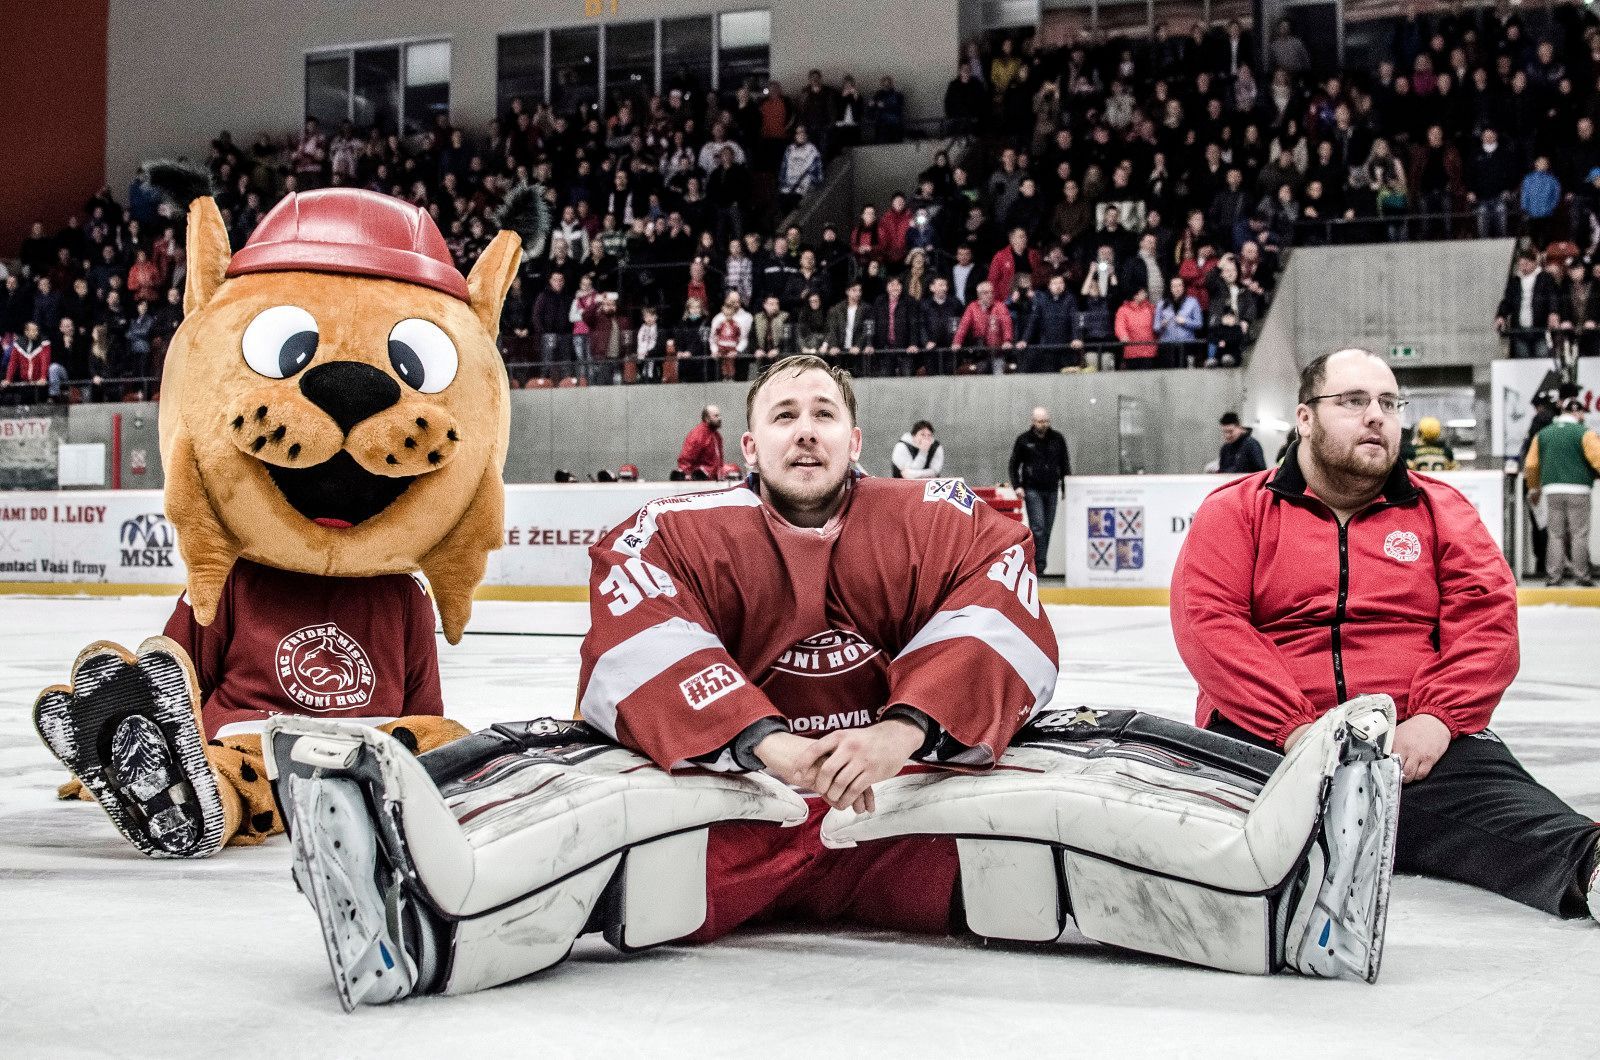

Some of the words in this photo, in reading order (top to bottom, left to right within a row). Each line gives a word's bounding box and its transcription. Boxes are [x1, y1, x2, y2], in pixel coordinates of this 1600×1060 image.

[73, 560, 106, 578] firmy
[120, 549, 174, 568] MSK
[598, 557, 678, 617] 30
[986, 543, 1040, 620] 30
[280, 655, 292, 678] HC
[688, 665, 737, 705] #53
